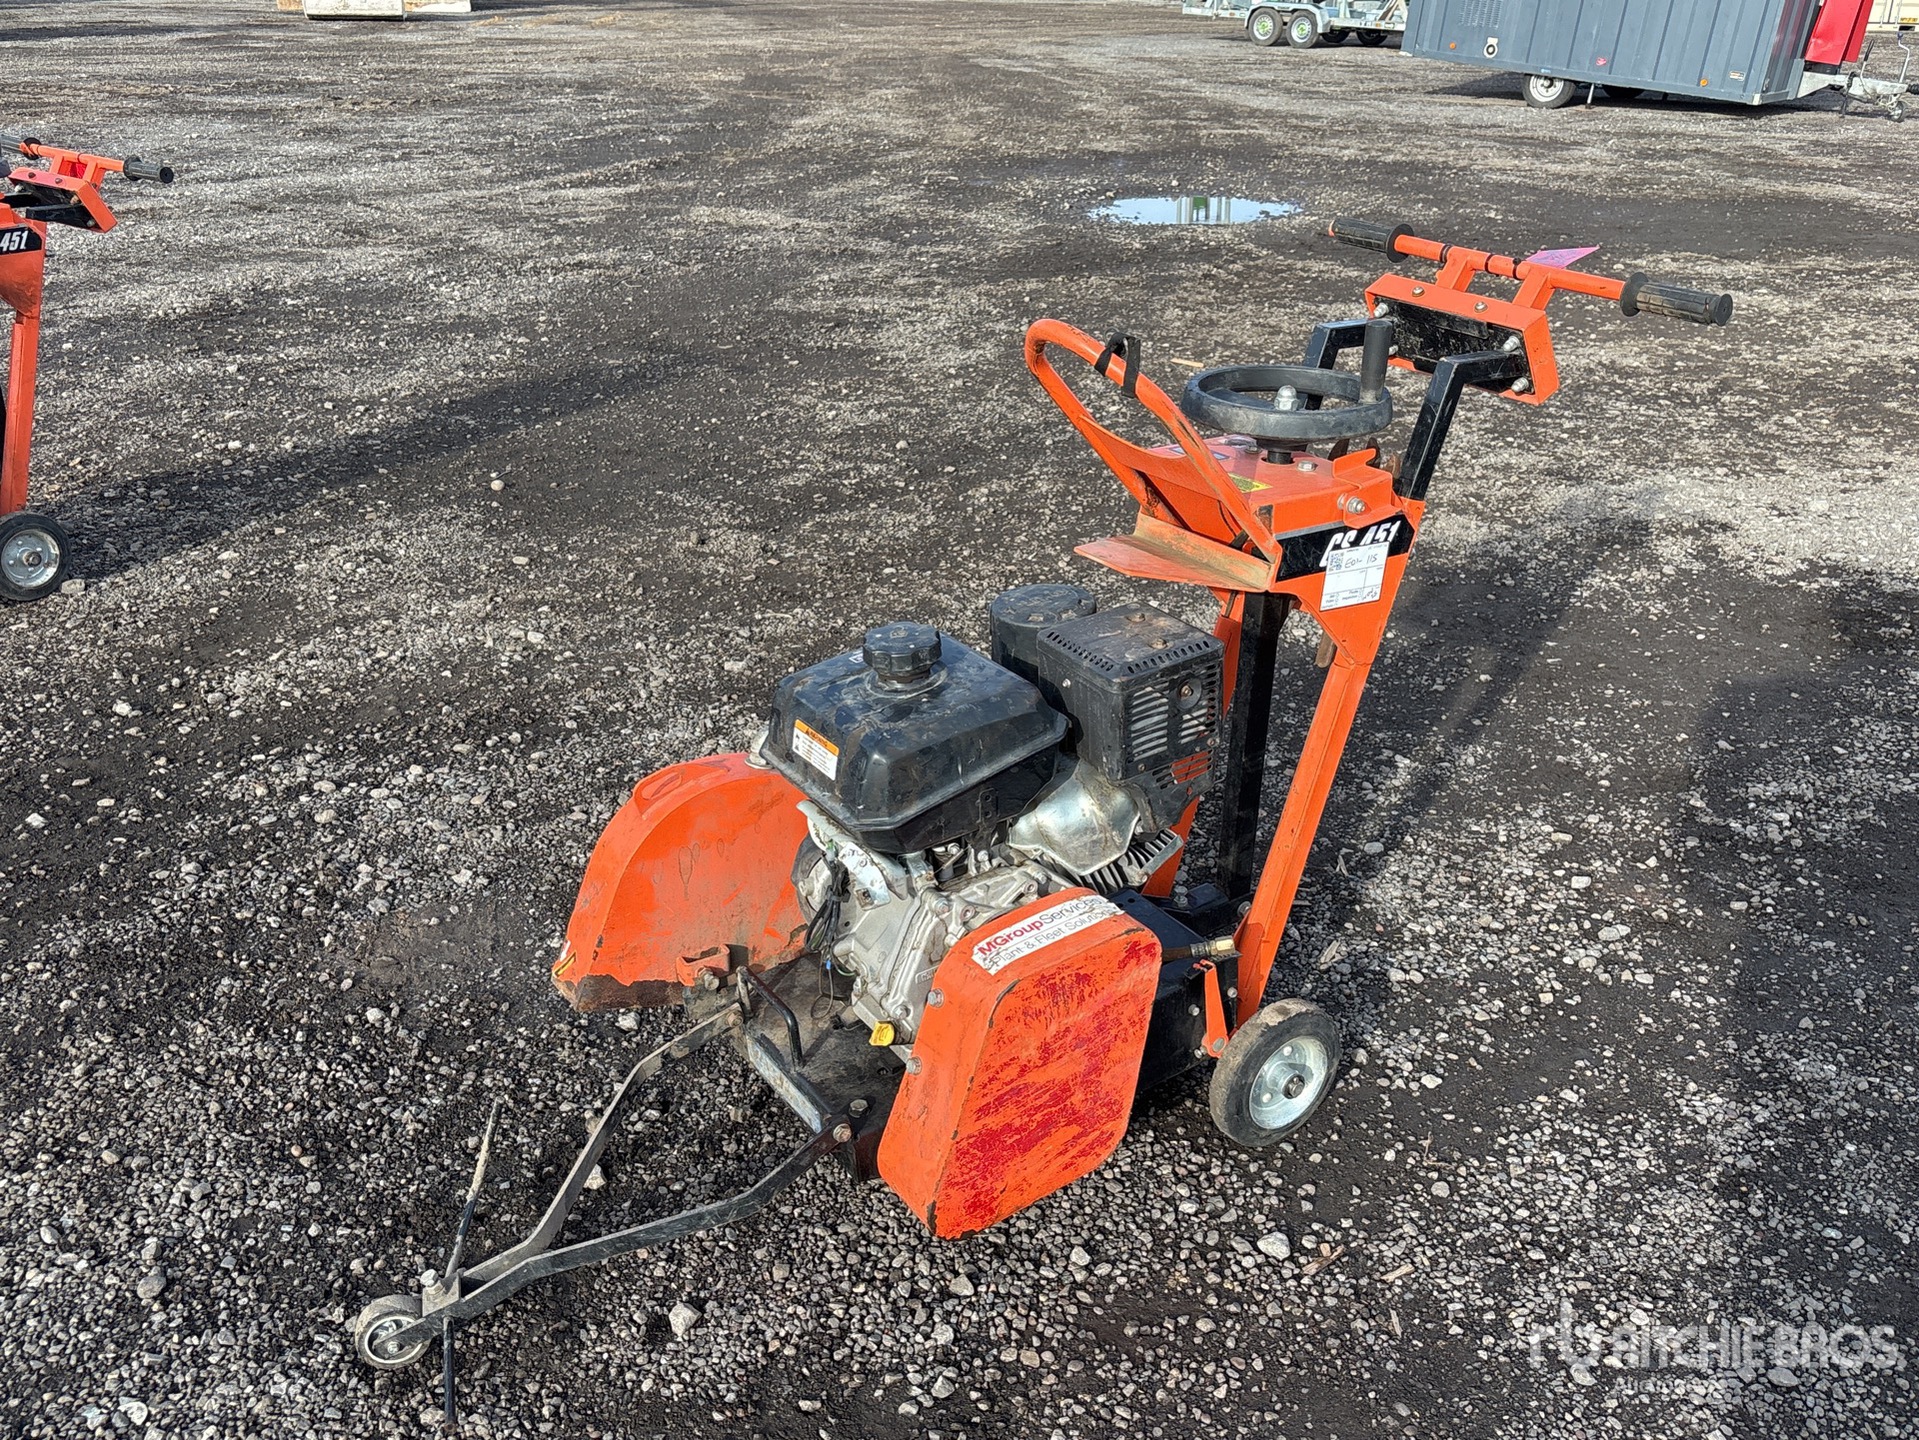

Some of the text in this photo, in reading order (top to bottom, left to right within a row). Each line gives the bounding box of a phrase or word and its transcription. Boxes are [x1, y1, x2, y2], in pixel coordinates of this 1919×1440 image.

[0, 230, 29, 252] 451
[990, 945, 1026, 967] Plant
[1024, 940, 1036, 950] &
[1035, 926, 1066, 945] Fleet
